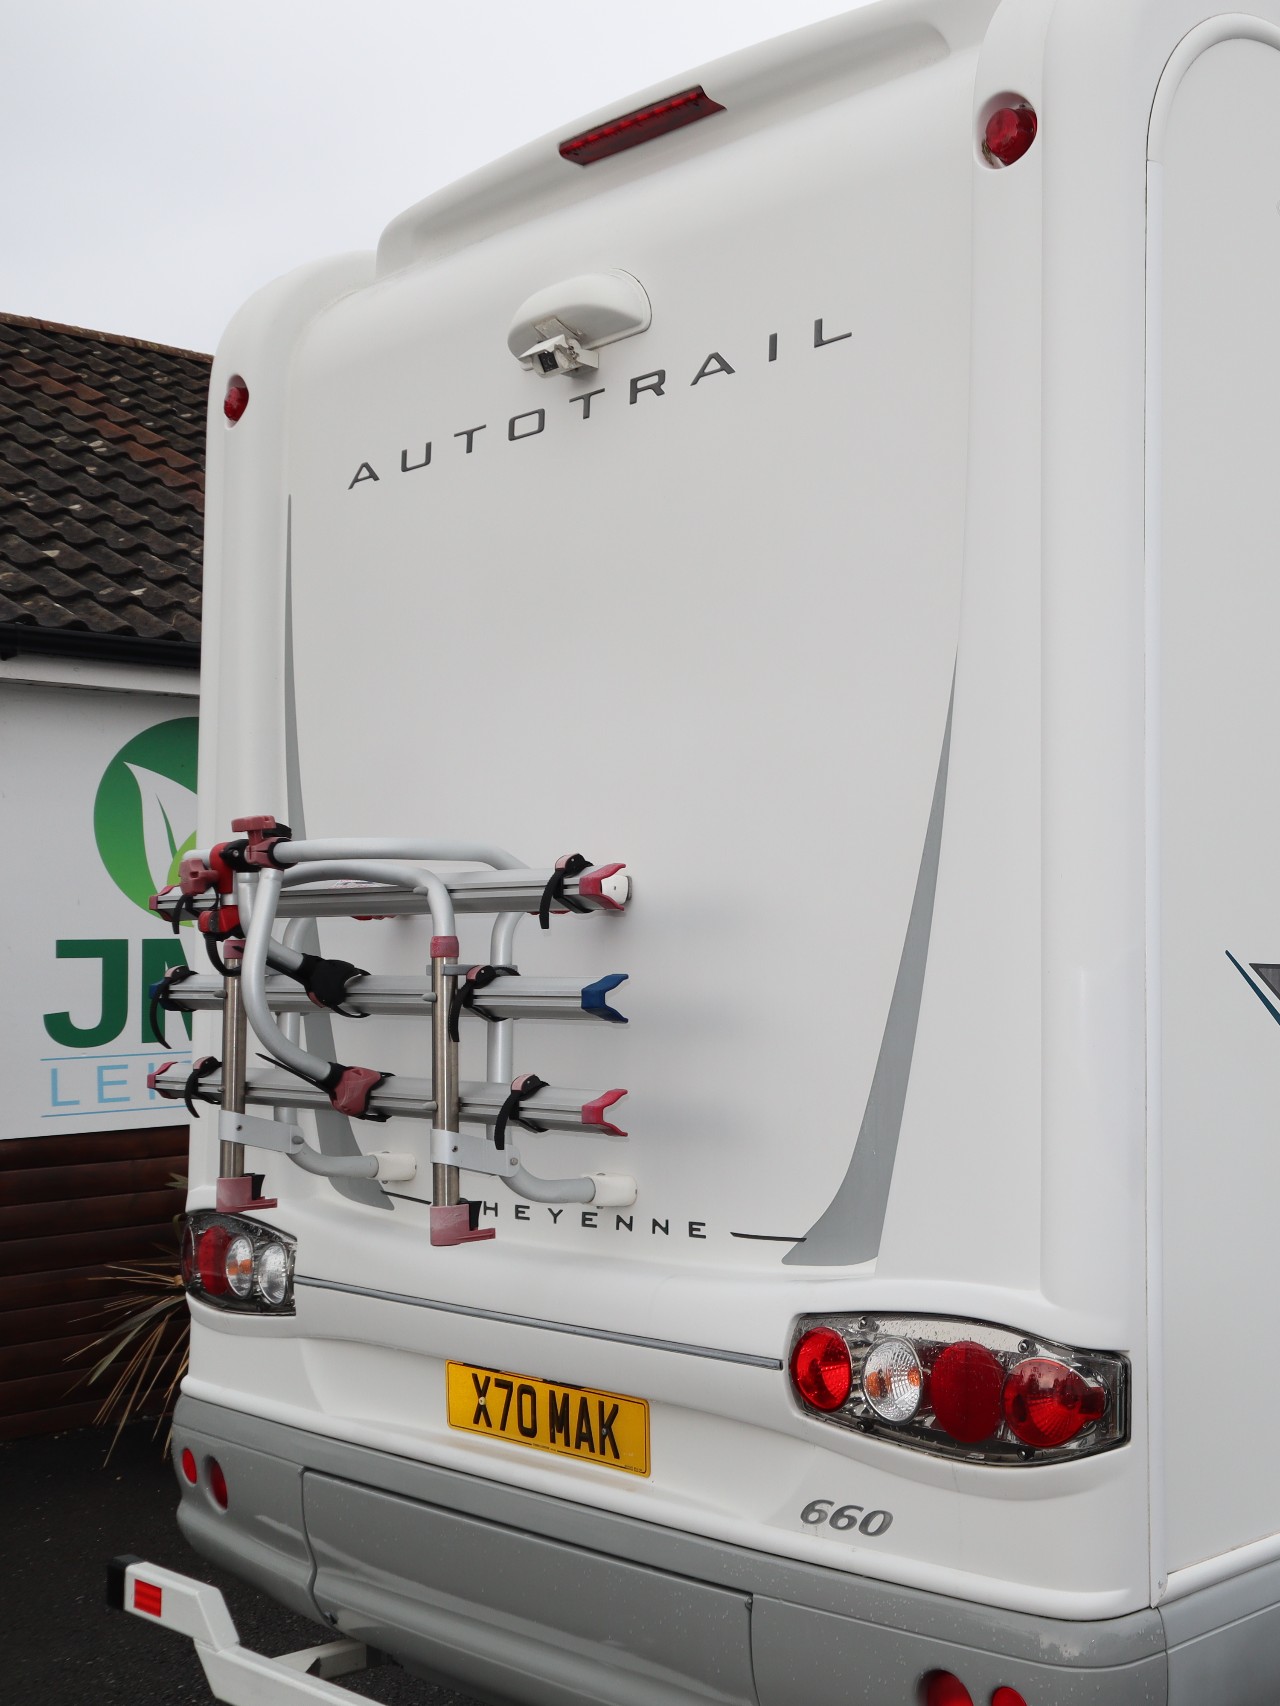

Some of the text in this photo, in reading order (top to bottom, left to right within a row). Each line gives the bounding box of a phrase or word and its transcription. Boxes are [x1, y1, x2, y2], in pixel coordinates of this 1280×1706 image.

[348, 318, 852, 490] AUTOTRAIL
[481, 1200, 707, 1239] HEYENNE
[472, 1373, 620, 1459] X70 MAK
[800, 1499, 894, 1537] 660
